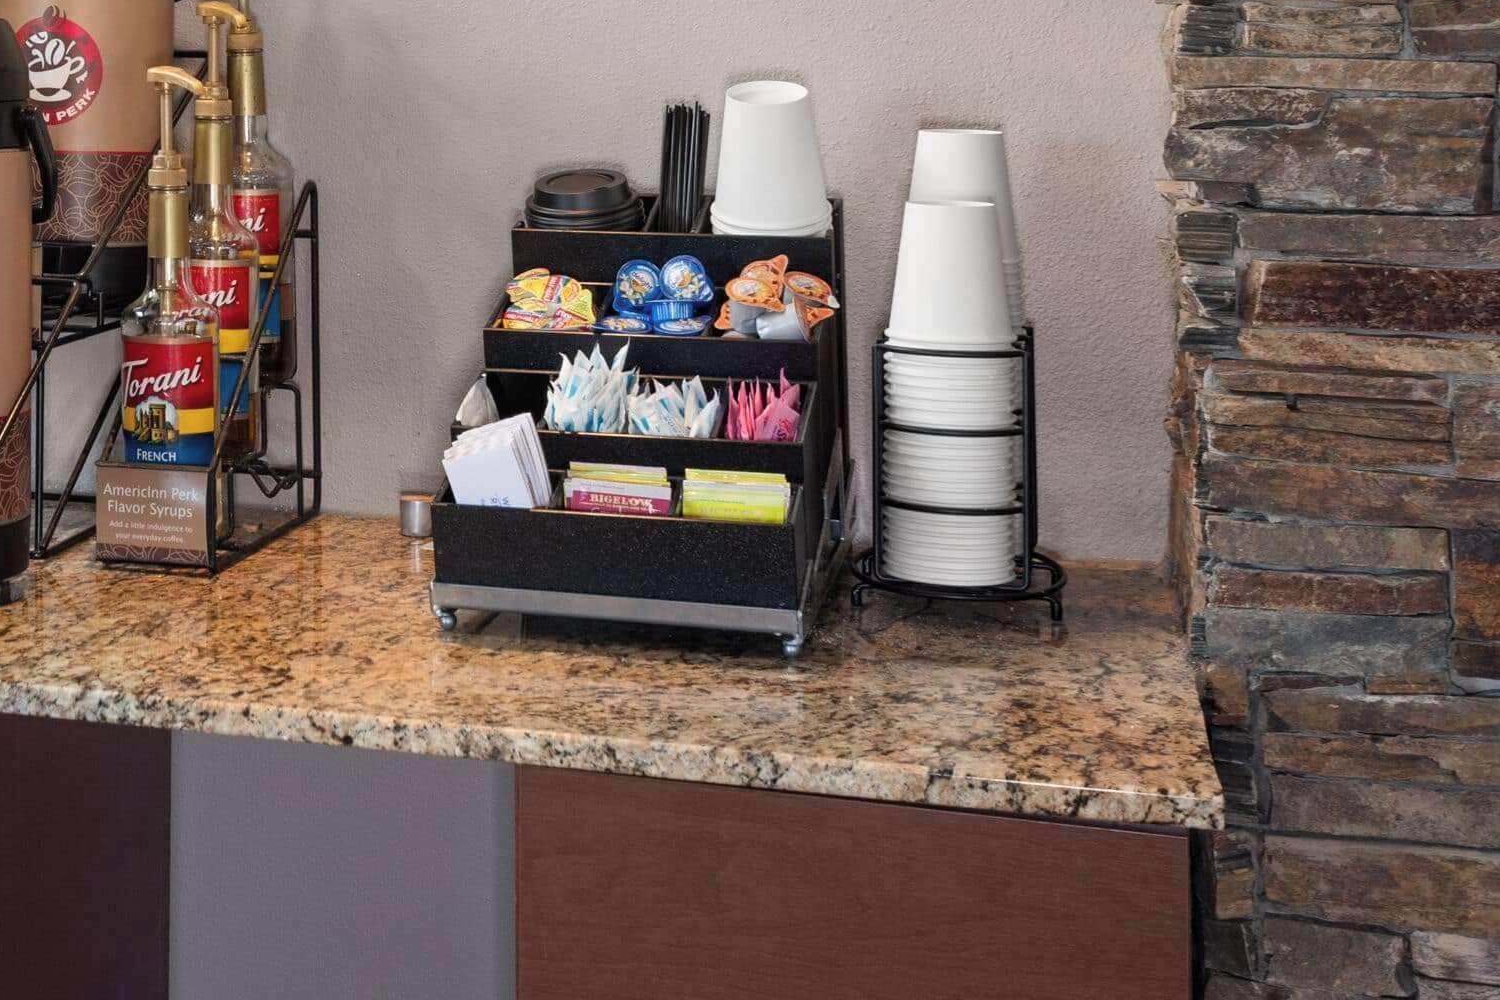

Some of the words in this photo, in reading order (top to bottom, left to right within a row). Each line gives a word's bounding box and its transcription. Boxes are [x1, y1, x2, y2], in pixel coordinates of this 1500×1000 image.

[55, 87, 96, 122] PERK
[122, 355, 204, 407] Torani
[136, 448, 177, 462] FRENCH
[103, 483, 167, 499] AmericInn
[171, 487, 198, 501] Perk
[590, 493, 652, 507] BIGELOW
[107, 500, 146, 514] Flavor
[149, 502, 193, 519] Syrups
[109, 520, 123, 529] Add
[147, 522, 184, 533] indulgence
